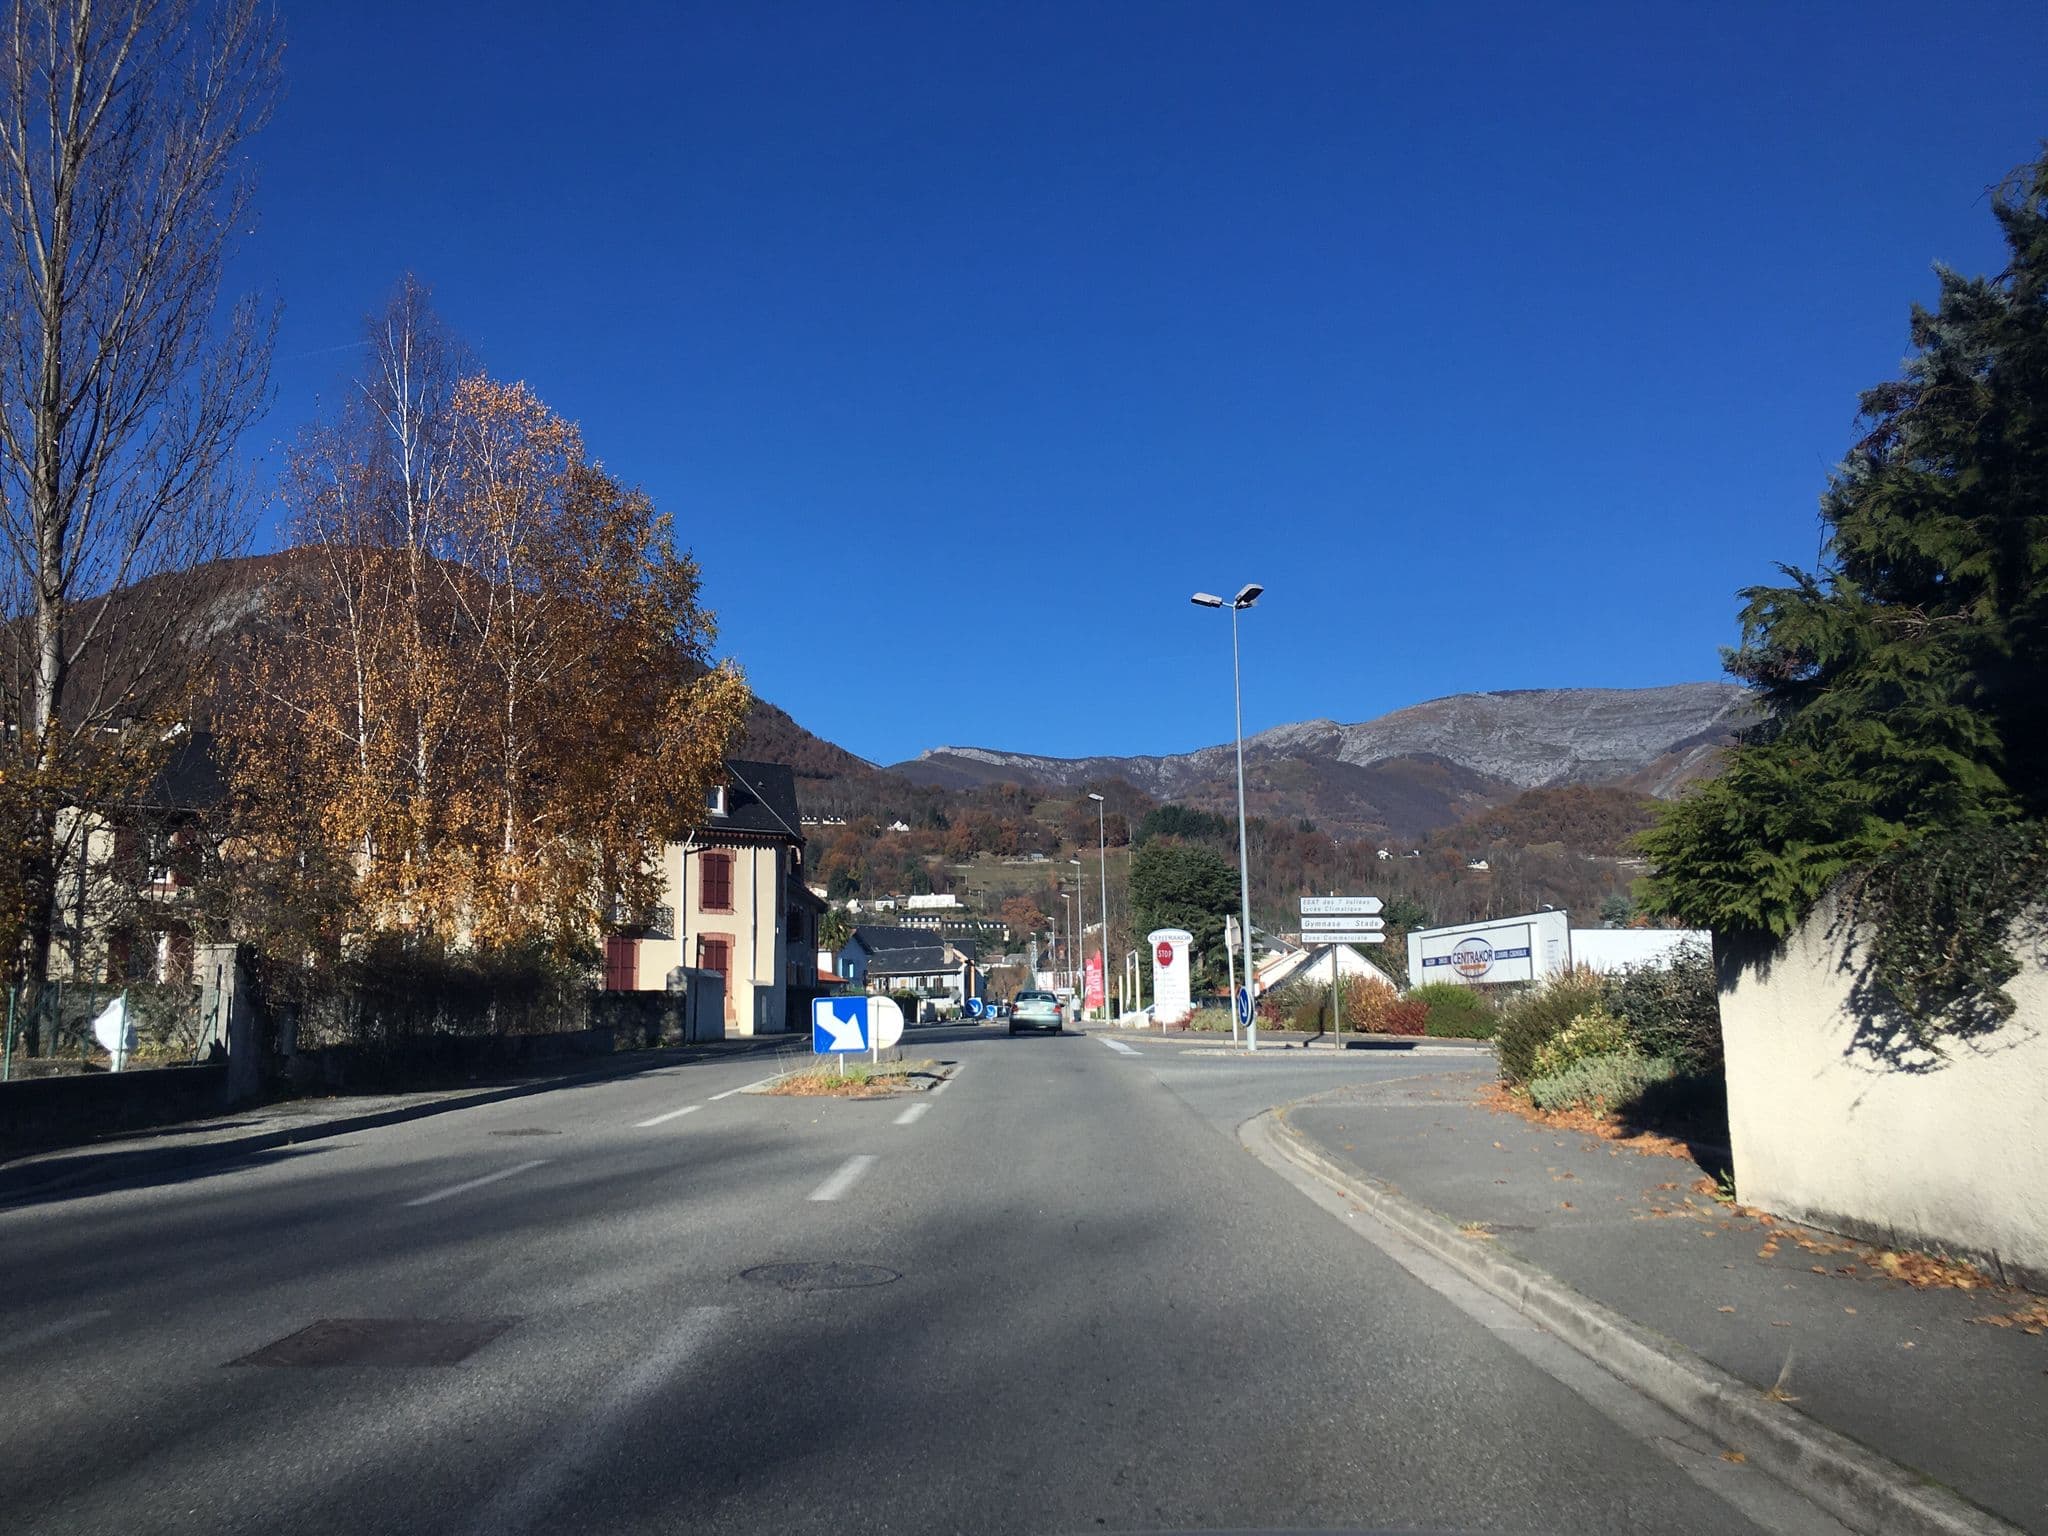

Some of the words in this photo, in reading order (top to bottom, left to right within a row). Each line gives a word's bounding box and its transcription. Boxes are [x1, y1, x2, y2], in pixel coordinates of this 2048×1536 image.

[1304, 920, 1341, 928] Gymnase
[1158, 950, 1172, 958] STOP
[1452, 950, 1494, 965] CENTRAKOR
